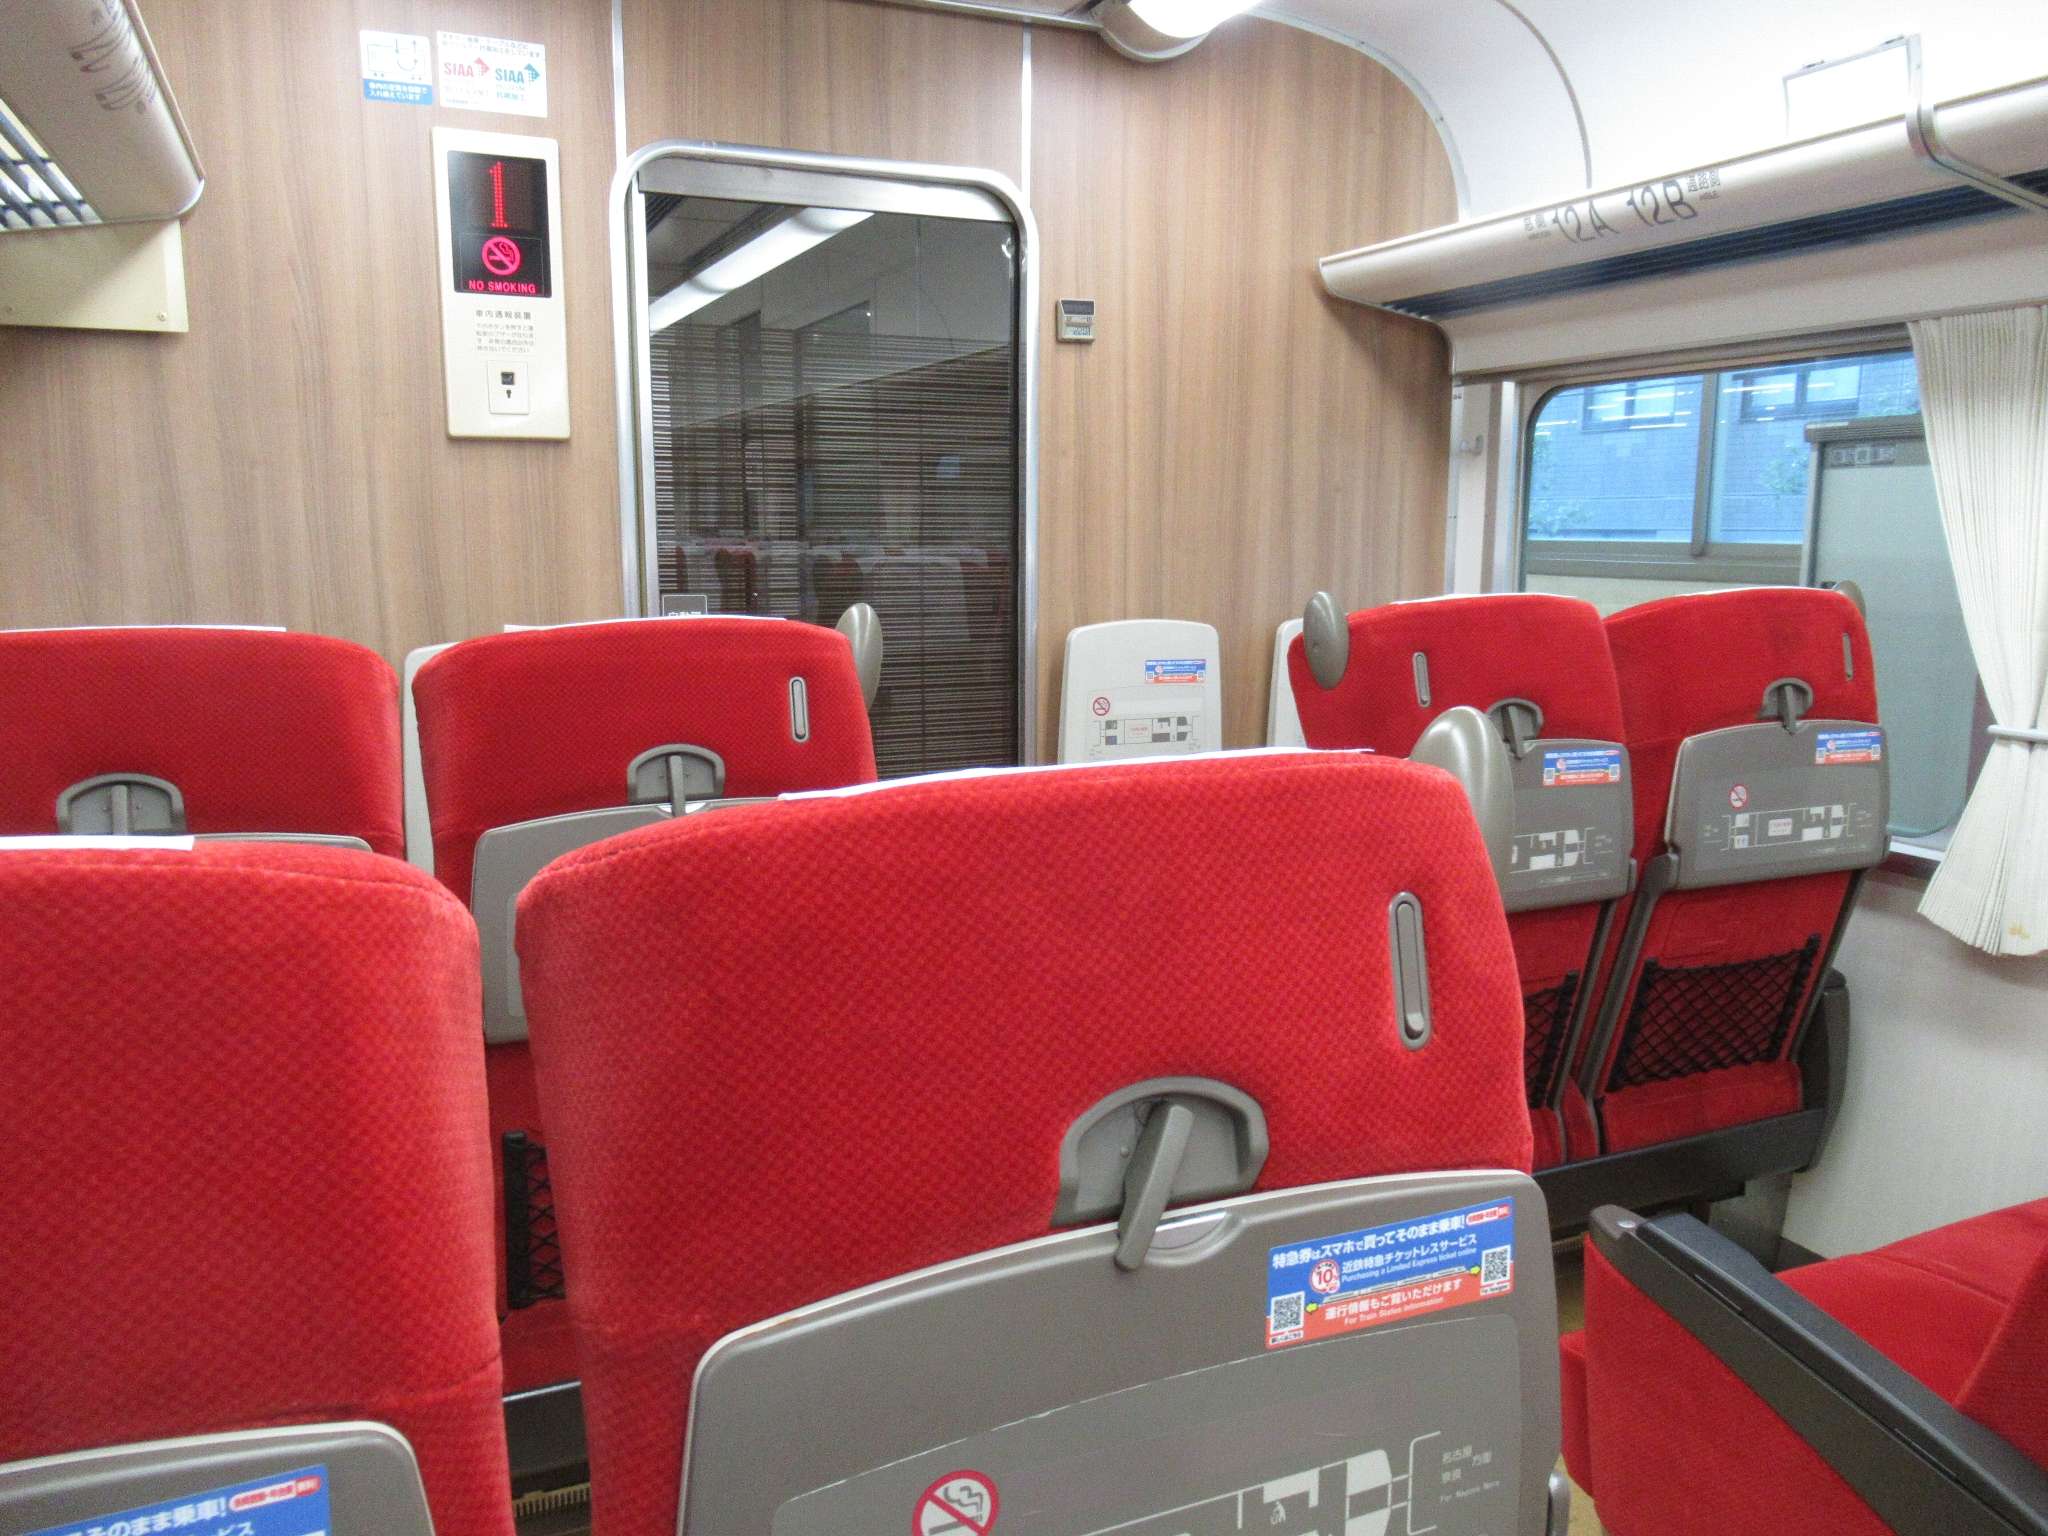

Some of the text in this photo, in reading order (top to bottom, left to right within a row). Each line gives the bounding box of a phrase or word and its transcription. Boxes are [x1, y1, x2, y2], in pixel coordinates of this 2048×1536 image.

[443, 62, 474, 78] SIAA
[495, 68, 525, 84] SIAA
[489, 160, 509, 229] 1
[1553, 199, 1620, 244] 12A
[1627, 179, 1698, 227] 12B
[468, 279, 536, 294] NO SMOKING
[1342, 1233, 1478, 1274] 近鉄特急チケットレスサービス
